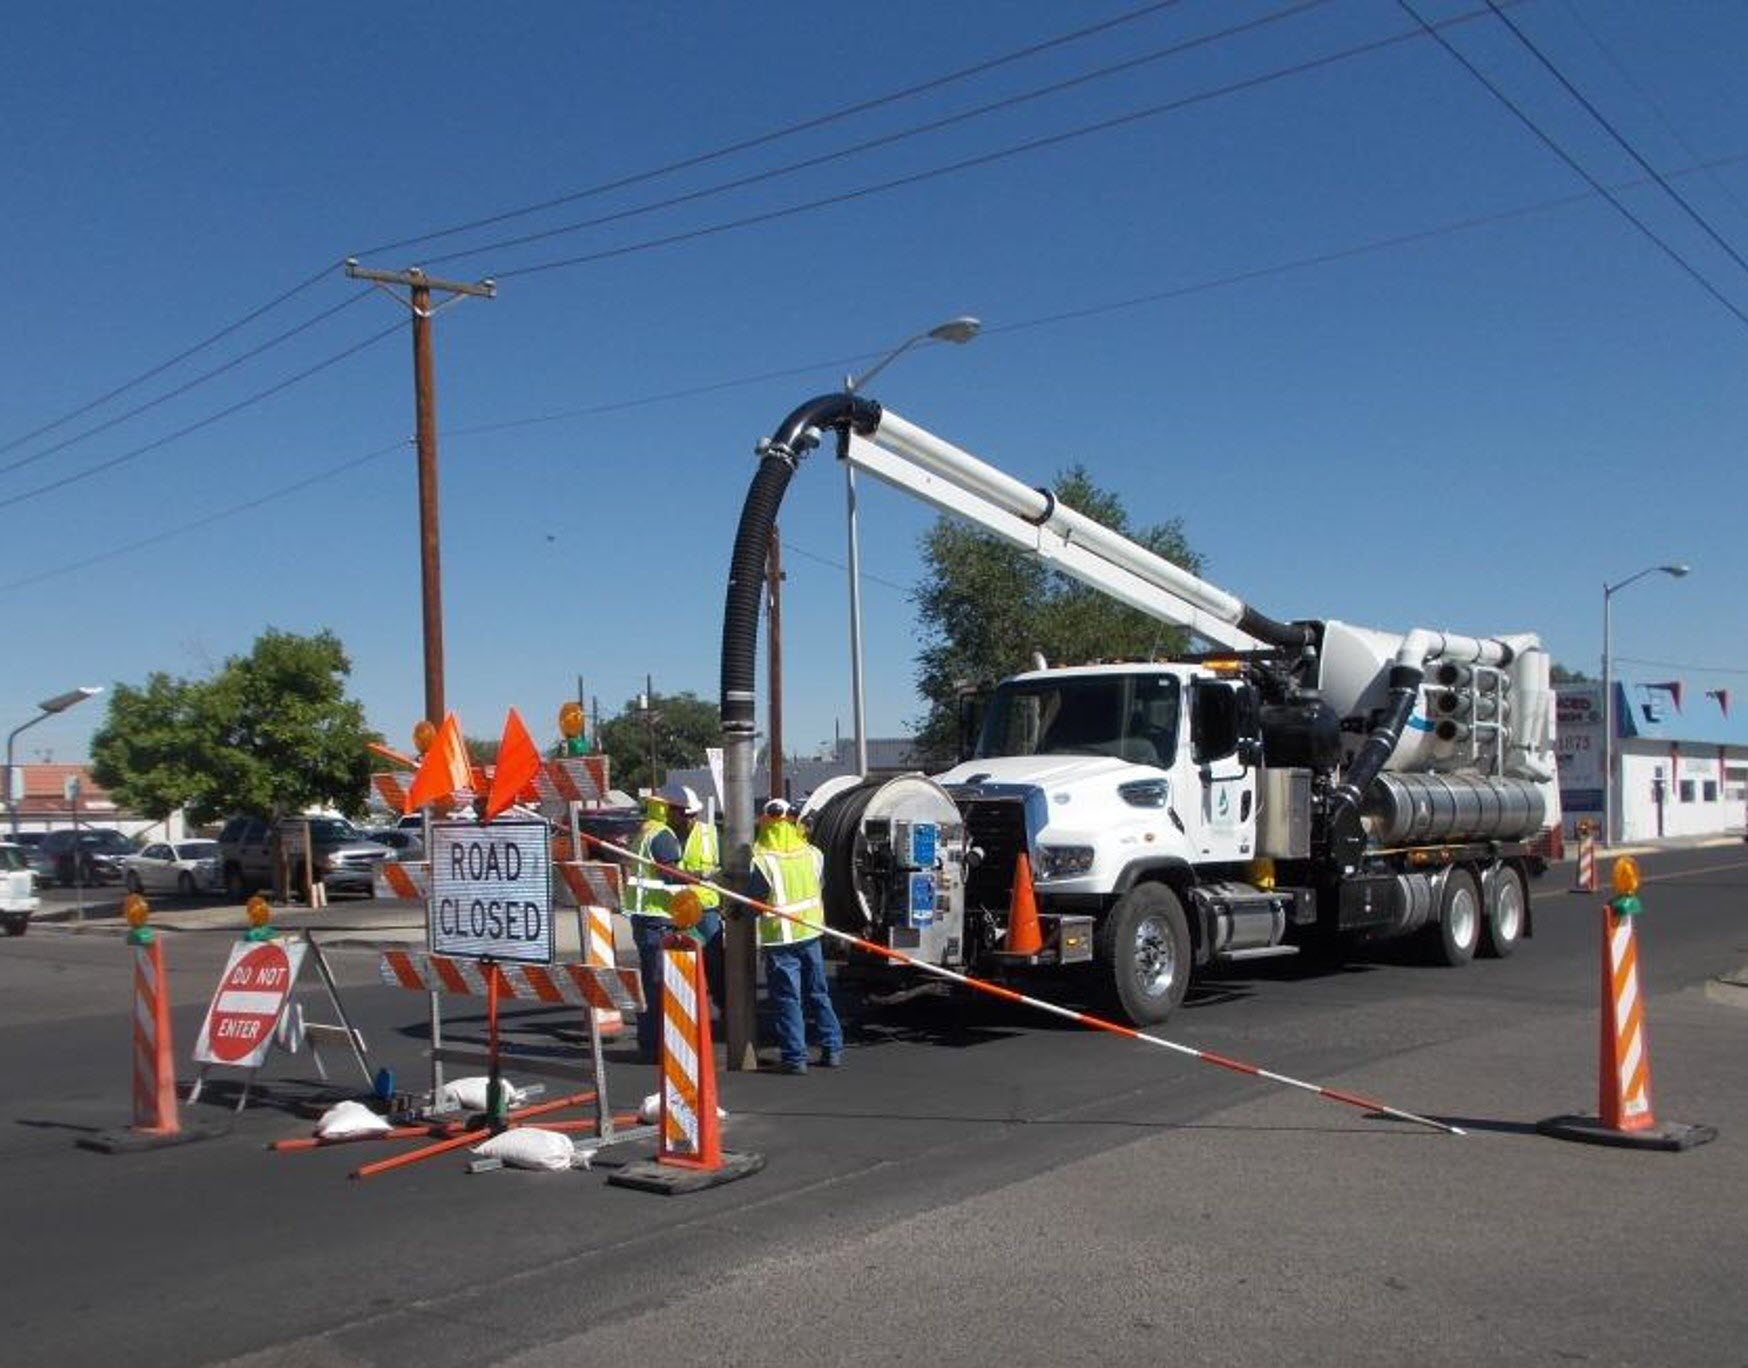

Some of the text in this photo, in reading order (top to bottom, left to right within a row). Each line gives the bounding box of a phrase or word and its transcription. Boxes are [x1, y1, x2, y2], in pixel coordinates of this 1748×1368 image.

[451, 842, 521, 881] ROAD
[440, 899, 541, 941] CLOSED
[231, 966, 288, 986] DO NOT
[217, 1018, 261, 1039] ENTER
